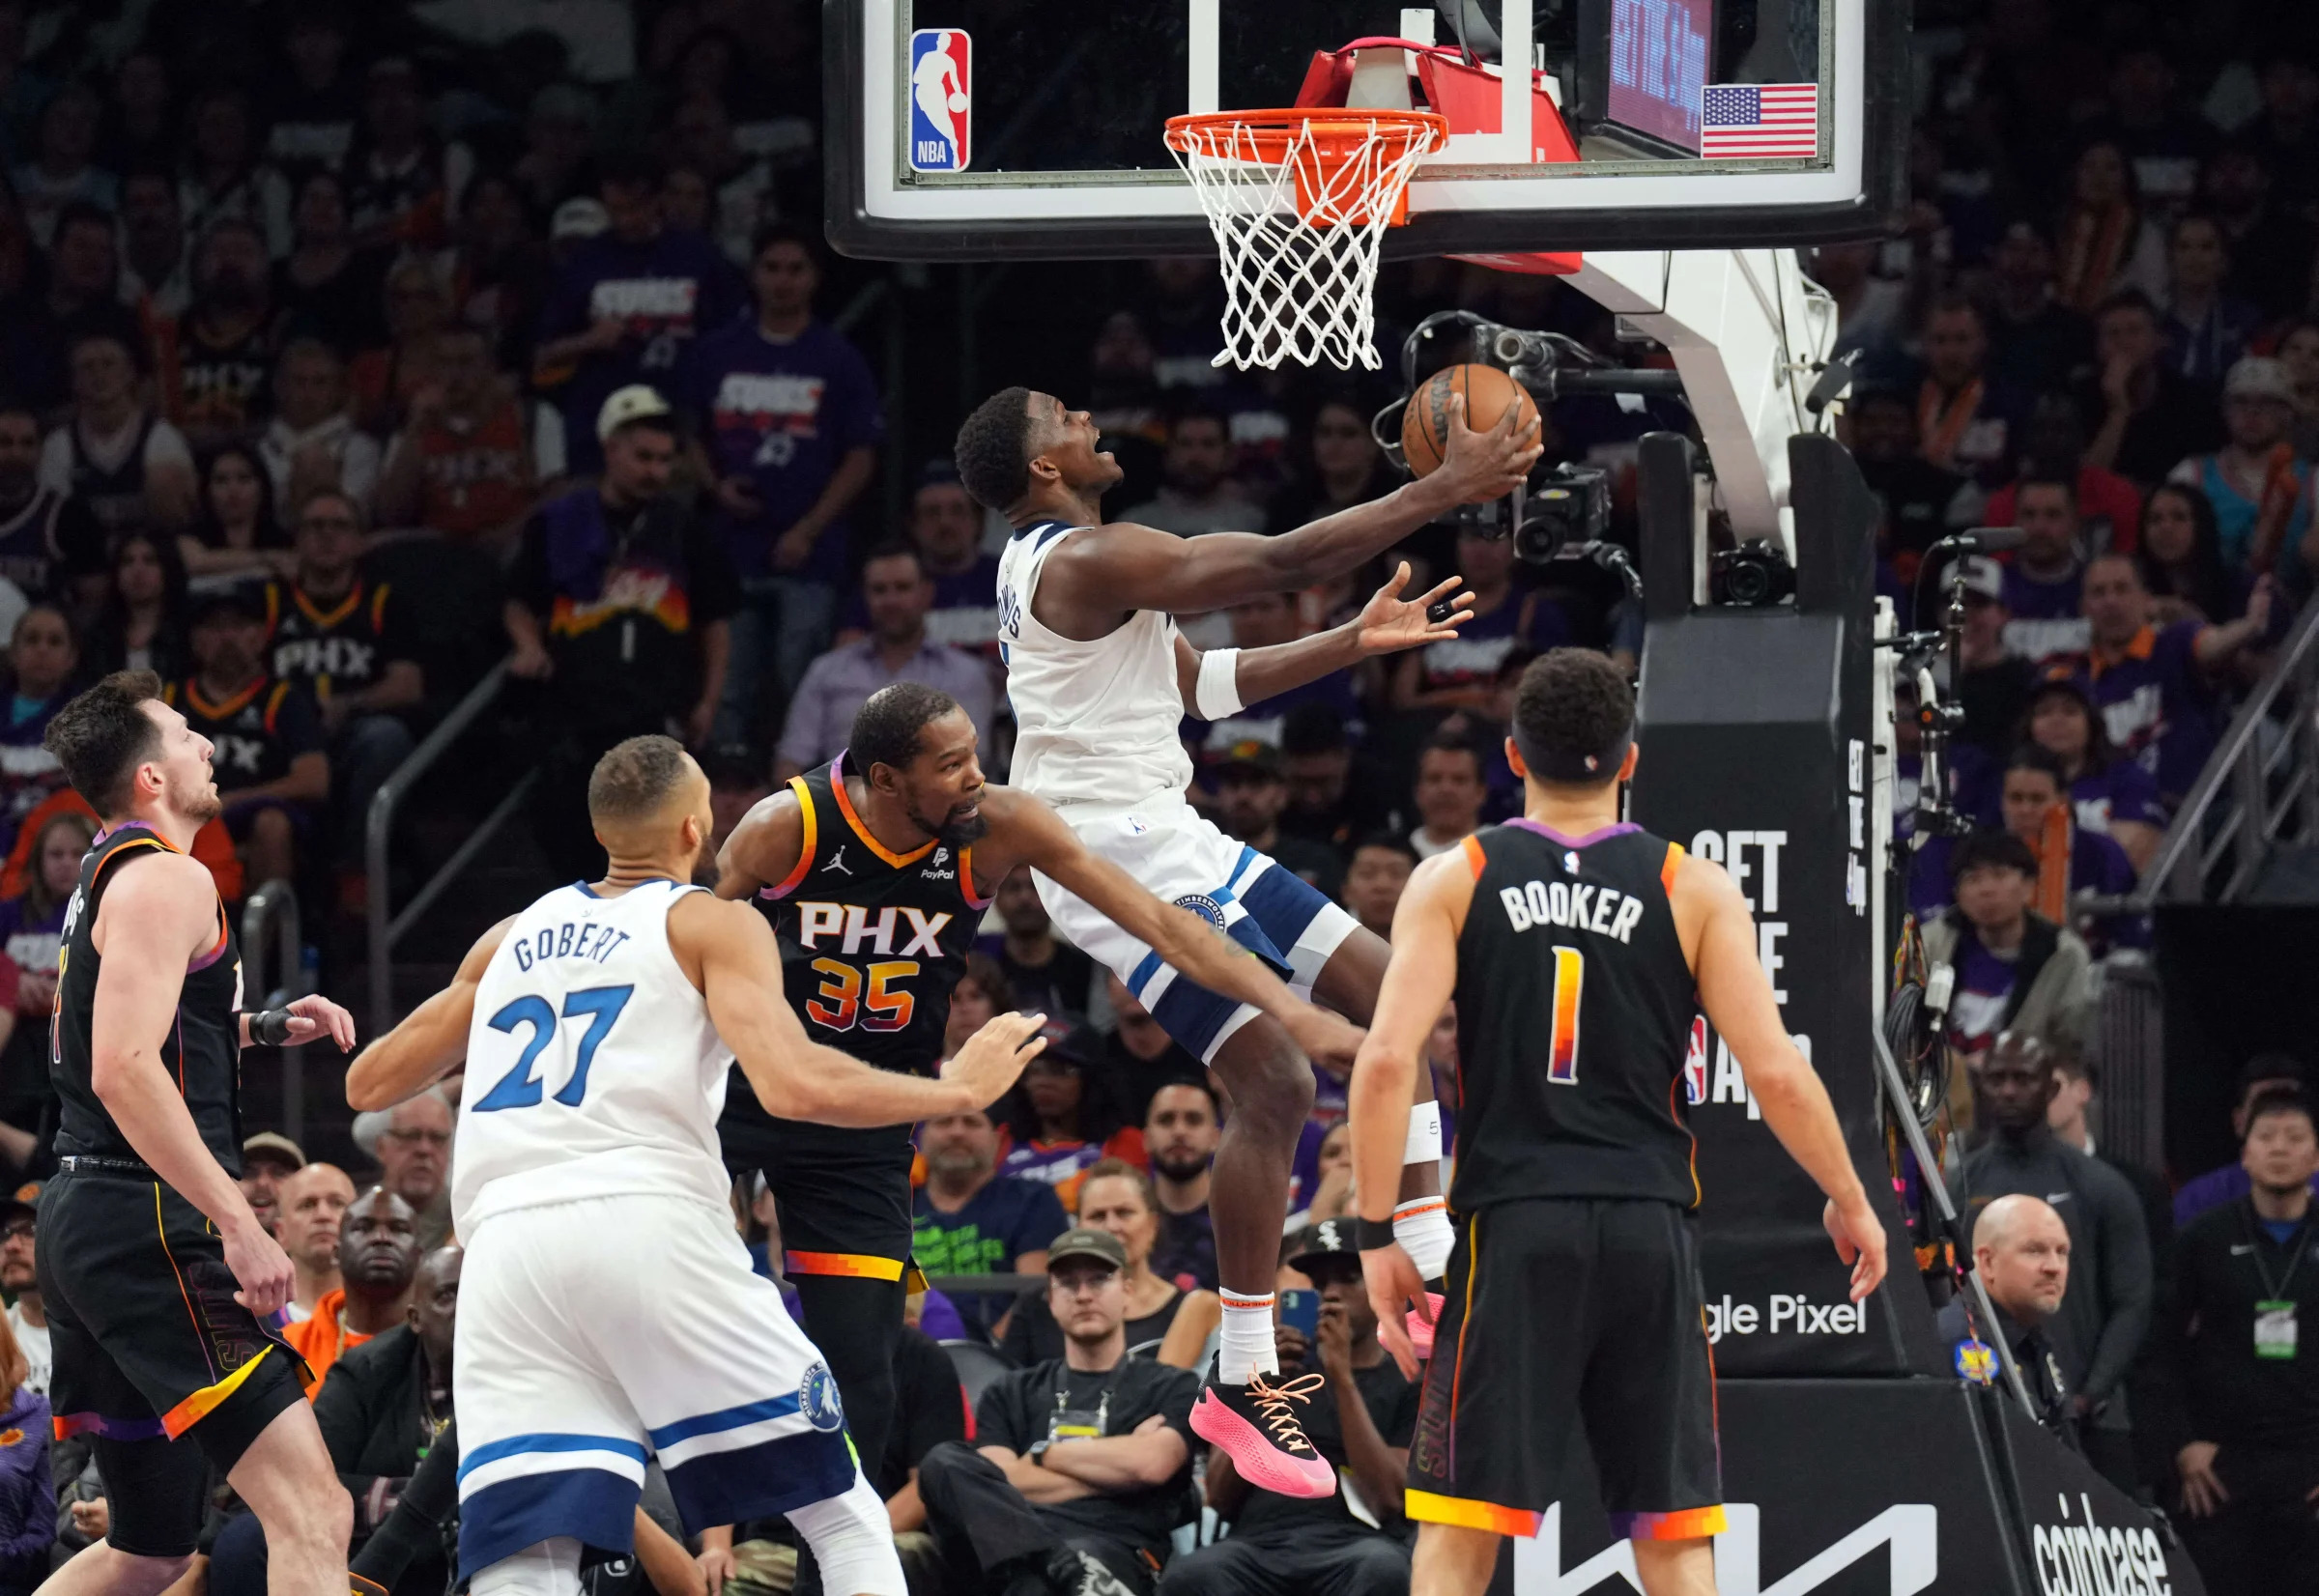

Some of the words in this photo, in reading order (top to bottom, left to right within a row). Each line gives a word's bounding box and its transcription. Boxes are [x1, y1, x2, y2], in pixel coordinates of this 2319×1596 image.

[918, 140, 947, 163] NBA
[274, 637, 376, 678] PHX
[921, 869, 955, 880] PayPal
[795, 901, 953, 957] PHX
[1176, 896, 1224, 930] TIMBERWOLVES
[1500, 880, 1645, 945] BOOKER
[514, 923, 631, 972] GOBERT
[806, 957, 920, 1032] 35
[1547, 945, 1585, 1086] 1
[471, 983, 635, 1112] 27
[1429, 1121, 1439, 1135] 5
[1770, 1295, 1866, 1334] Pixel
[2033, 1492, 2172, 1596] coinbase
